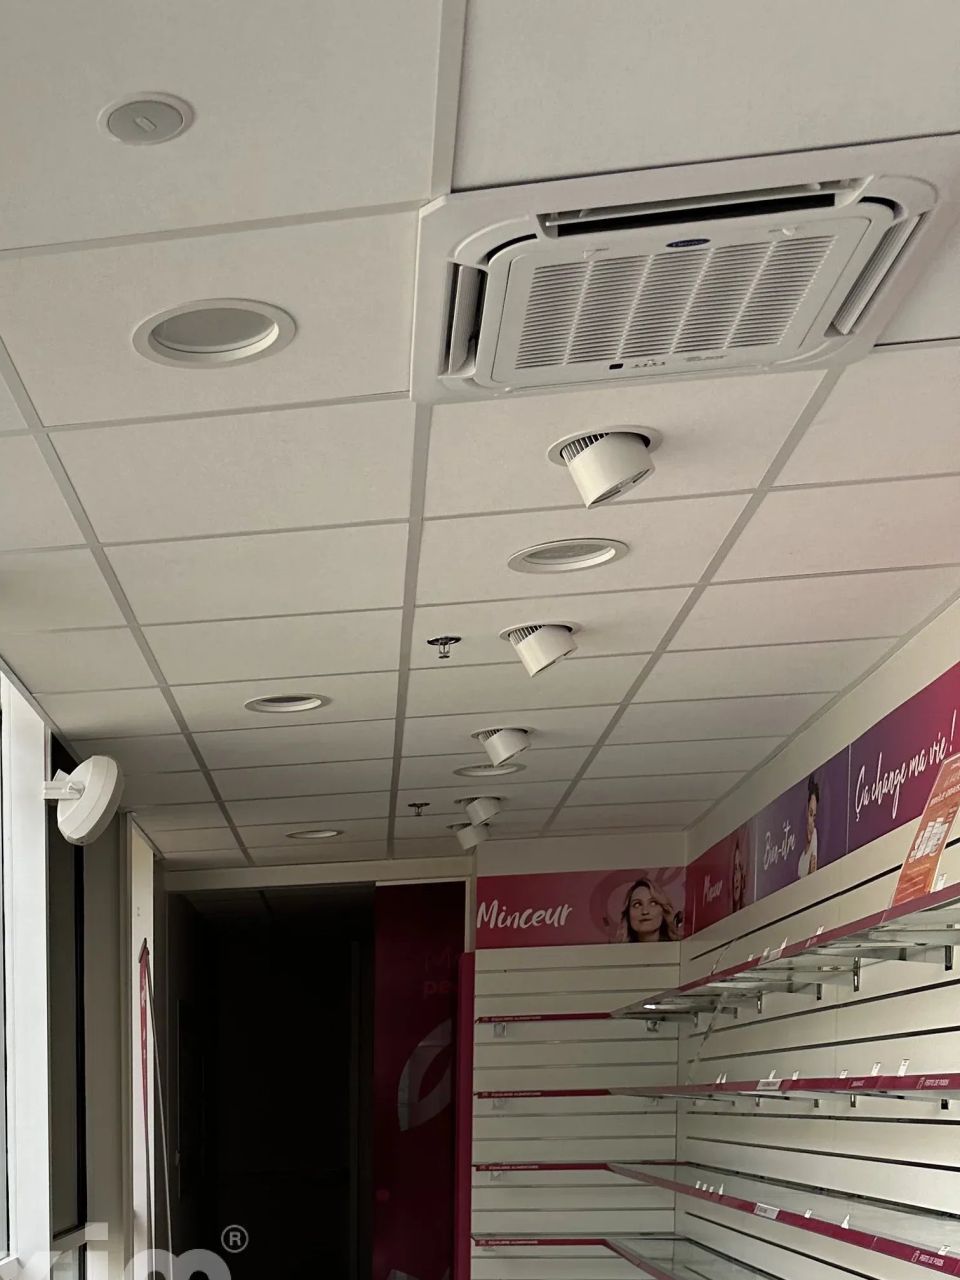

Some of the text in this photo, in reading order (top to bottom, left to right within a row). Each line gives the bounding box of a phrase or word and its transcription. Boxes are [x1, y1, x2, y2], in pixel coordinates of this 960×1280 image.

[871, 751, 908, 820] change
[908, 748, 928, 779] ma
[476, 898, 573, 931] Minceur
